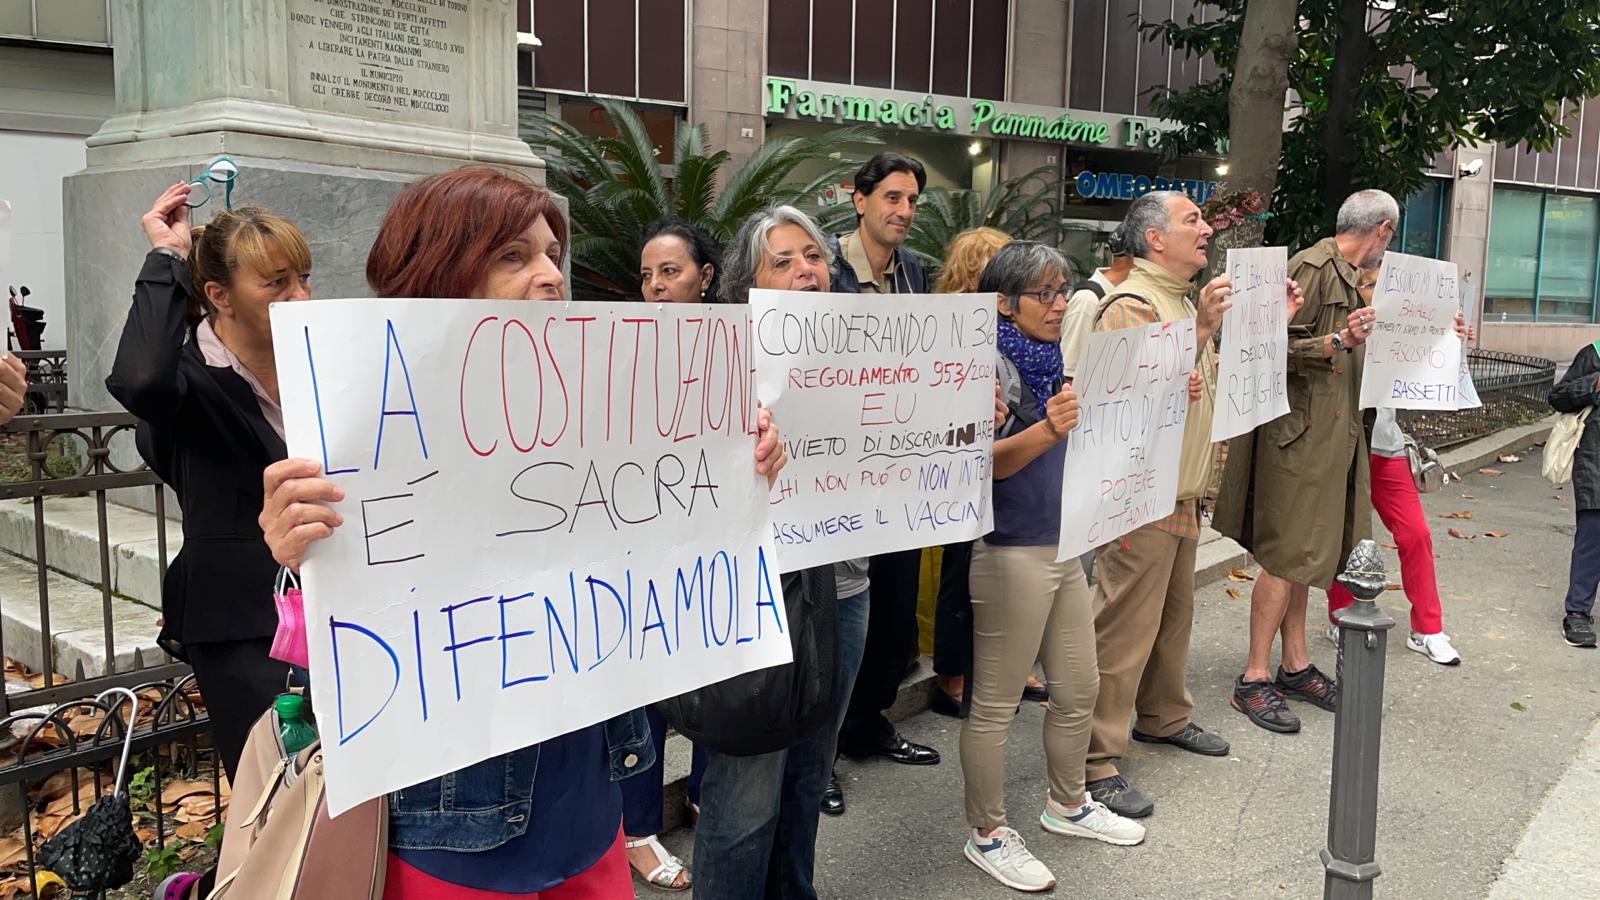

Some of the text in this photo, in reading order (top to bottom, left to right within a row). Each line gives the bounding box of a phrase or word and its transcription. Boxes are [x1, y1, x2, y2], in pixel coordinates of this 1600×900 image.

[290, 12, 316, 25] DONDE
[320, 17, 352, 33] VENNERO
[375, 28, 404, 42] ITALIANI
[408, 35, 420, 46] DEL
[423, 39, 447, 51] SECOLO
[420, 16, 447, 29] AFFETTI
[309, 41, 450, 74] A LIBERARE LA PATRIA DALLO STRANIERO
[361, 68, 403, 83] IL MUNICIPIO
[344, 77, 351, 86] IL
[353, 78, 393, 93] MONUMENTO
[397, 85, 410, 96] NEL
[365, 91, 391, 104] DECORO
[394, 96, 409, 107] NEL
[767, 76, 957, 131] Farmacia
[971, 100, 1112, 145] Pammatone
[757, 307, 938, 358] CONSIDERANDO
[788, 362, 920, 390] REGOLAMENTO
[1081, 322, 1194, 398] VIOLAZIONE
[304, 318, 429, 475] LA
[1391, 379, 1457, 402] BASSETTI
[860, 392, 917, 426] EU
[783, 419, 993, 460] IVIETO DI DISCRIMINARE
[1129, 446, 1146, 468] FRA
[495, 447, 719, 536] SACRA
[815, 470, 850, 494] NON
[900, 467, 912, 482] O
[918, 460, 952, 491] NON
[1100, 468, 1157, 504] POTERE
[772, 495, 987, 545] ASSUMERE IL VACCINO
[1087, 493, 1158, 544] CITTADINI
[329, 545, 783, 746] DIFENDIAMOLA
